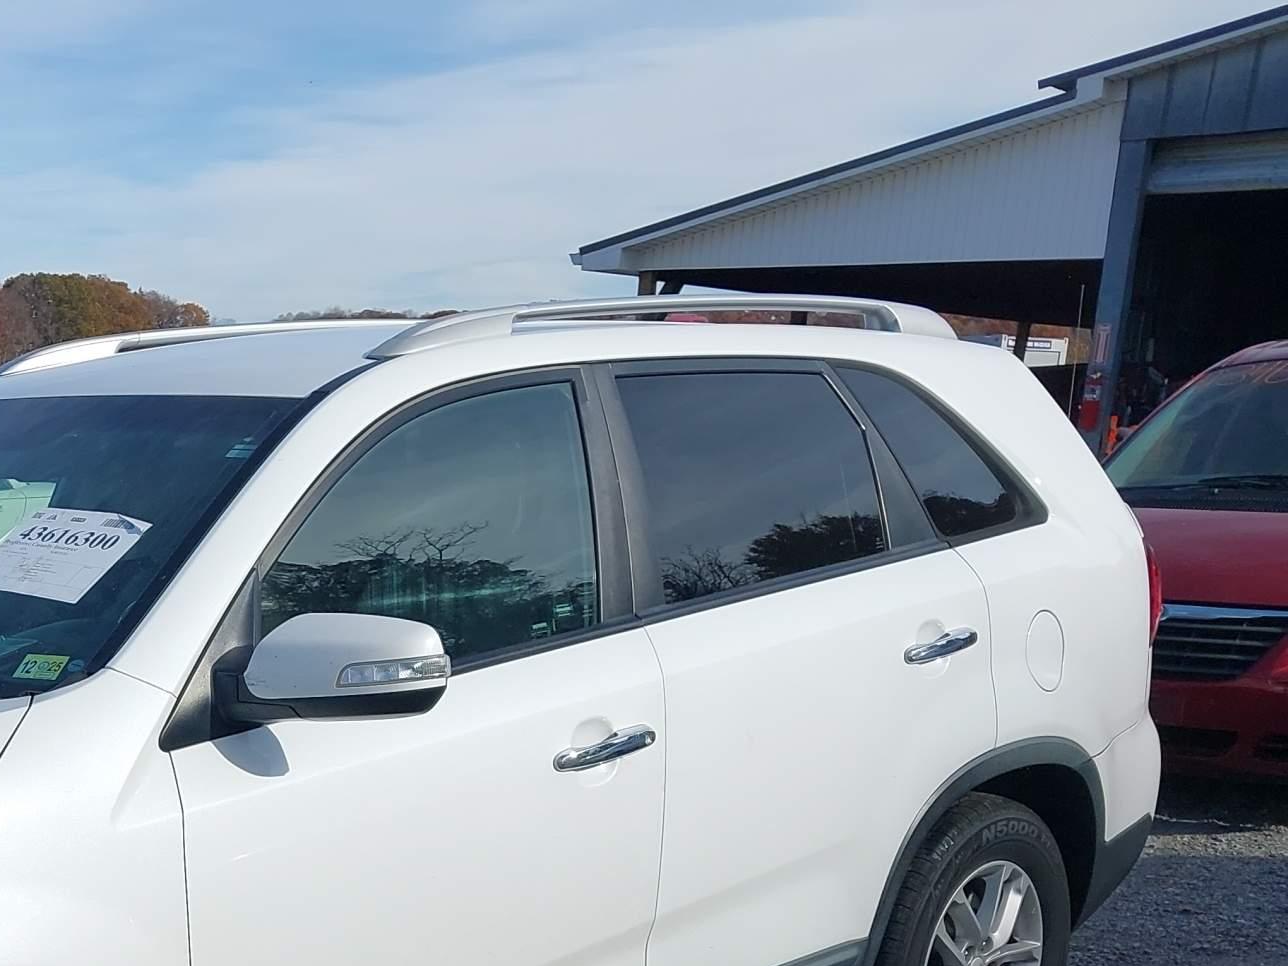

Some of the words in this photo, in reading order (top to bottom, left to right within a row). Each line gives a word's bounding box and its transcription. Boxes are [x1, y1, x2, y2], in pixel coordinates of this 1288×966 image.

[19, 525, 121, 550] 43616300
[20, 659, 37, 674] 12
[47, 661, 64, 672] 25
[982, 820, 1038, 846] N5000
